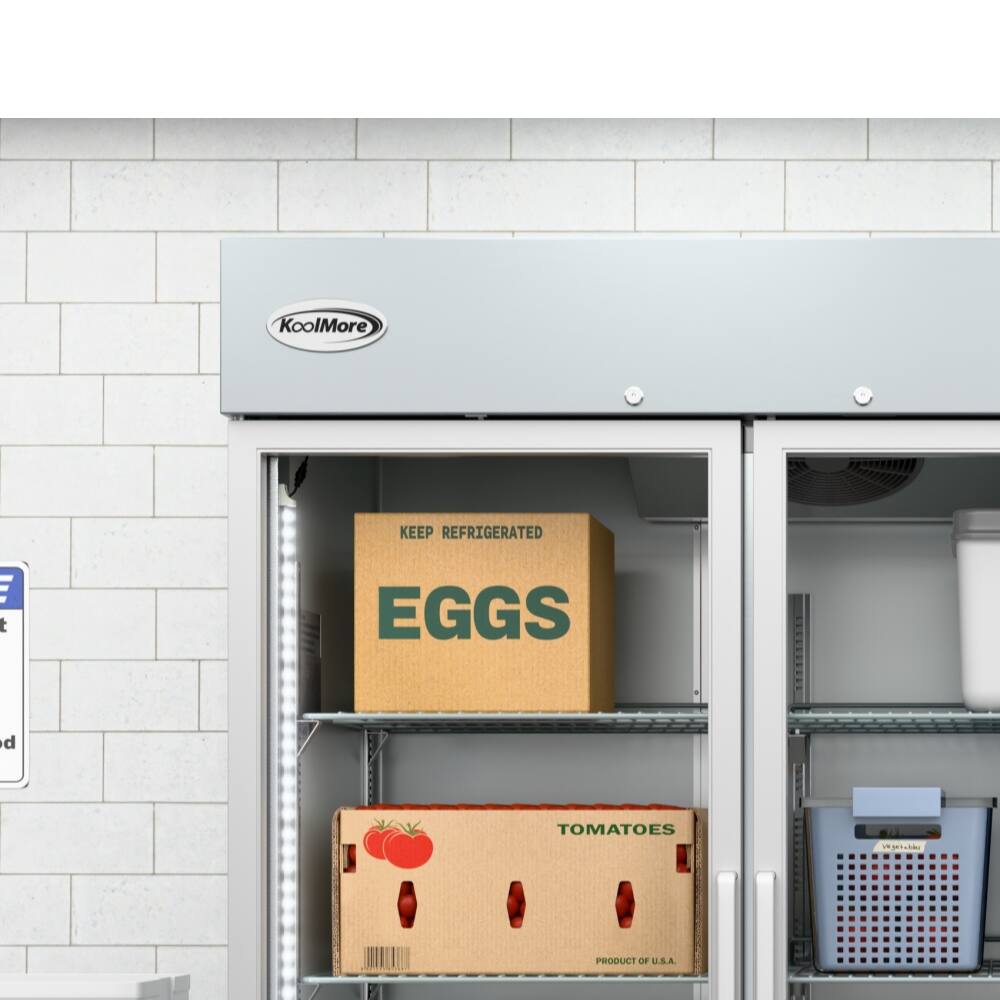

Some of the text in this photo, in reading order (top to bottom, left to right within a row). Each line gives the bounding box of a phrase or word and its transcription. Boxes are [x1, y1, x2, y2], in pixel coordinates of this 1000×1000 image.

[279, 317, 368, 333] KoolMore
[400, 525, 543, 540] KEEP REFRIGERATED
[378, 584, 571, 641] EGGS
[557, 823, 676, 836] TOMATOES
[596, 957, 677, 965] PRODUCT OF U.S.A.
